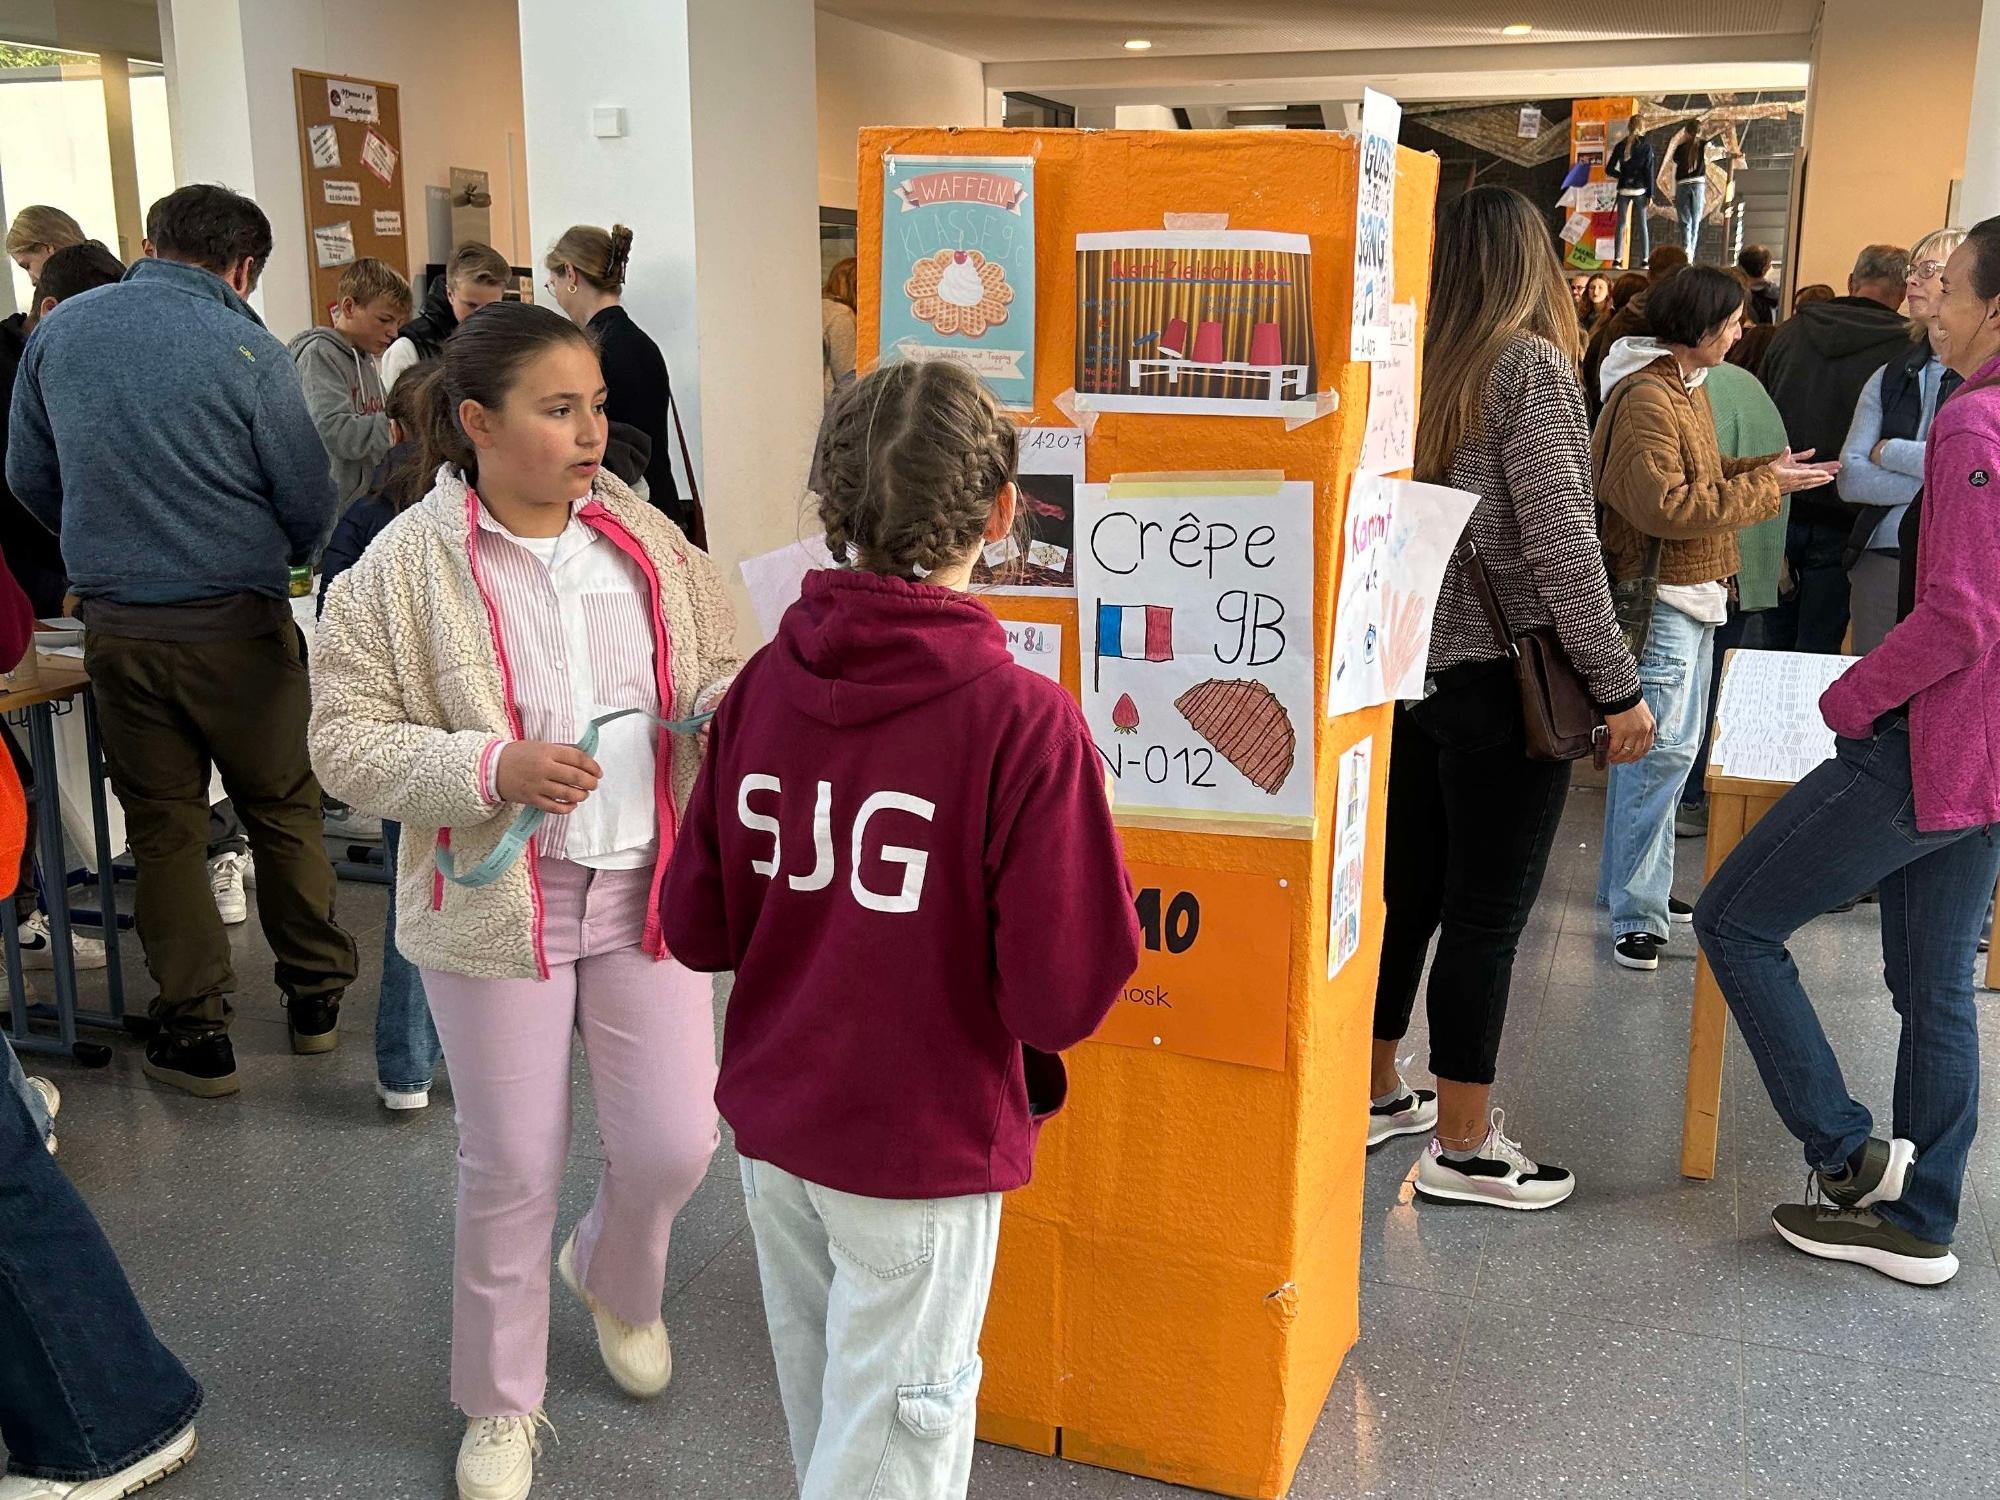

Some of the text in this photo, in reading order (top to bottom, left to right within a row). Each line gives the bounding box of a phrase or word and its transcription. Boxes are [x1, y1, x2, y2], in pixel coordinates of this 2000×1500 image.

[920, 175, 1010, 202] WAFFELN
[898, 208, 999, 262] KLASSE
[1358, 212, 1386, 271] SONG
[1091, 512, 1275, 579] Crêpe
[737, 773, 936, 913] SJG
[1117, 985, 1173, 1009] iosk
